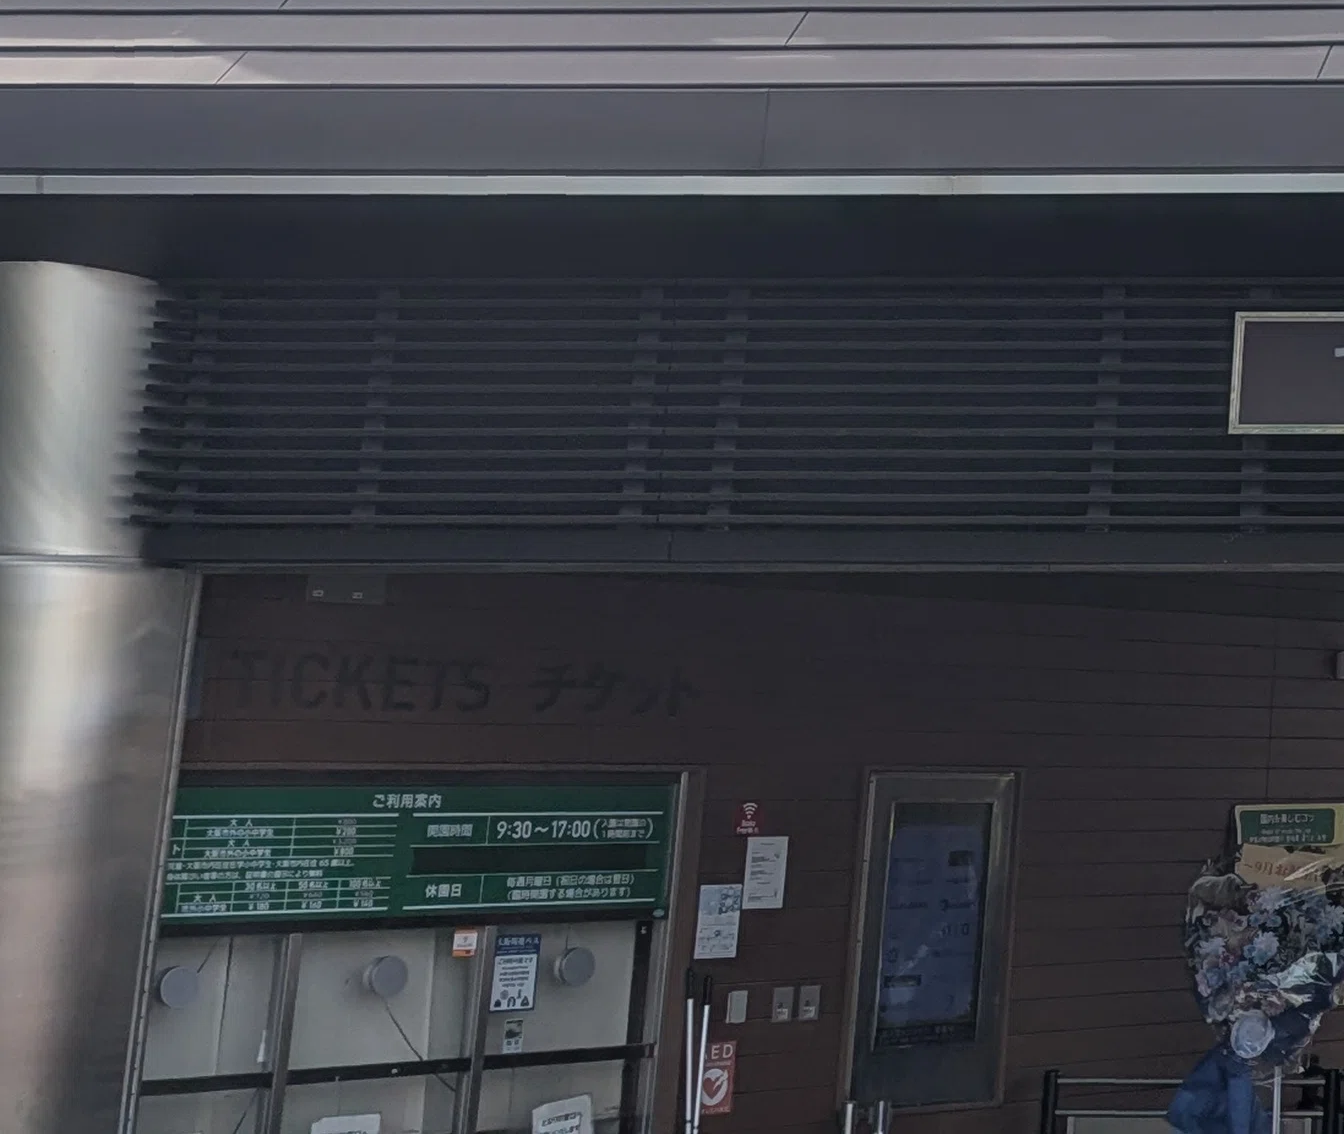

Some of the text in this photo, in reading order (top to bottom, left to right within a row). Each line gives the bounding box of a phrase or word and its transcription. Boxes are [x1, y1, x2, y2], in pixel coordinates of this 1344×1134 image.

[372, 793, 442, 809] ご利用案内
[703, 1044, 734, 1065] ED
